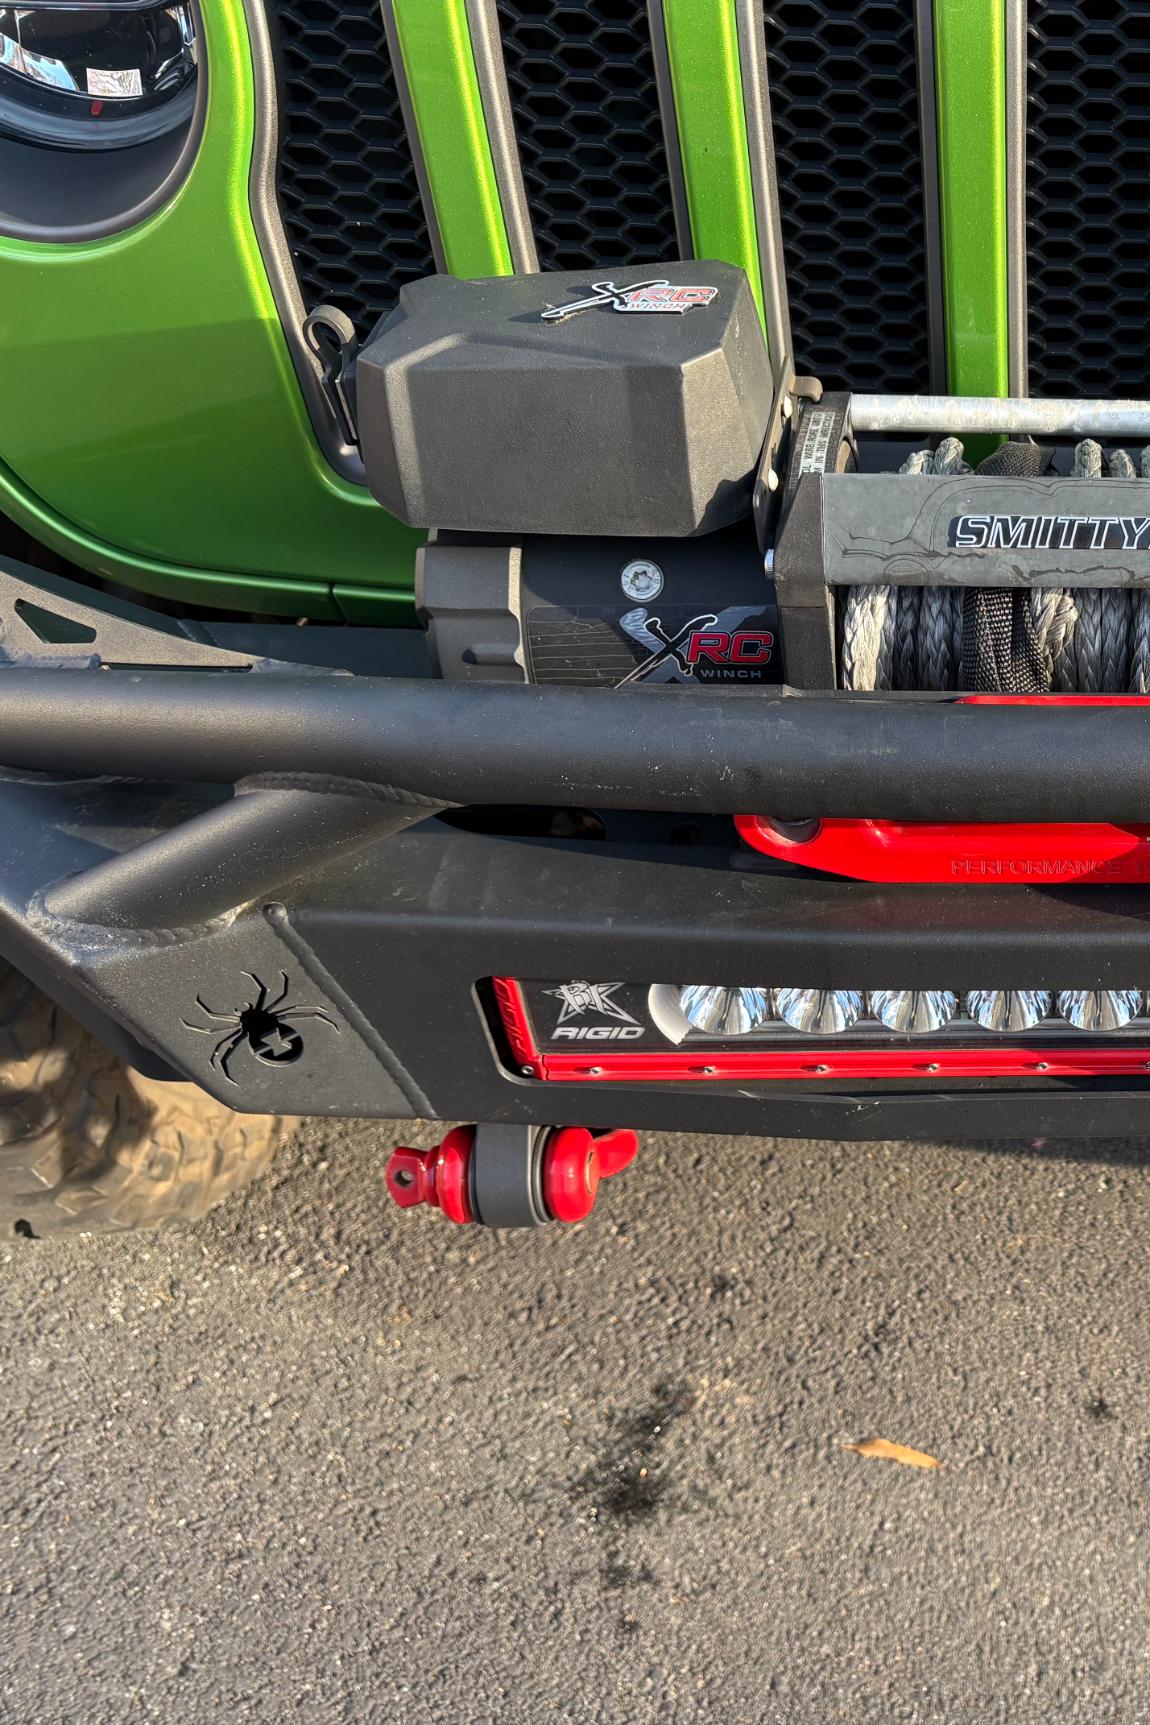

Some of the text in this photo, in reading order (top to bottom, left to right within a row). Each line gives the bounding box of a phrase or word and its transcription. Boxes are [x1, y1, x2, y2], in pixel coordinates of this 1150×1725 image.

[700, 669, 762, 679] WINCH
[949, 859, 1123, 876] PERFORMANCE
[550, 1026, 646, 1040] RIGID
